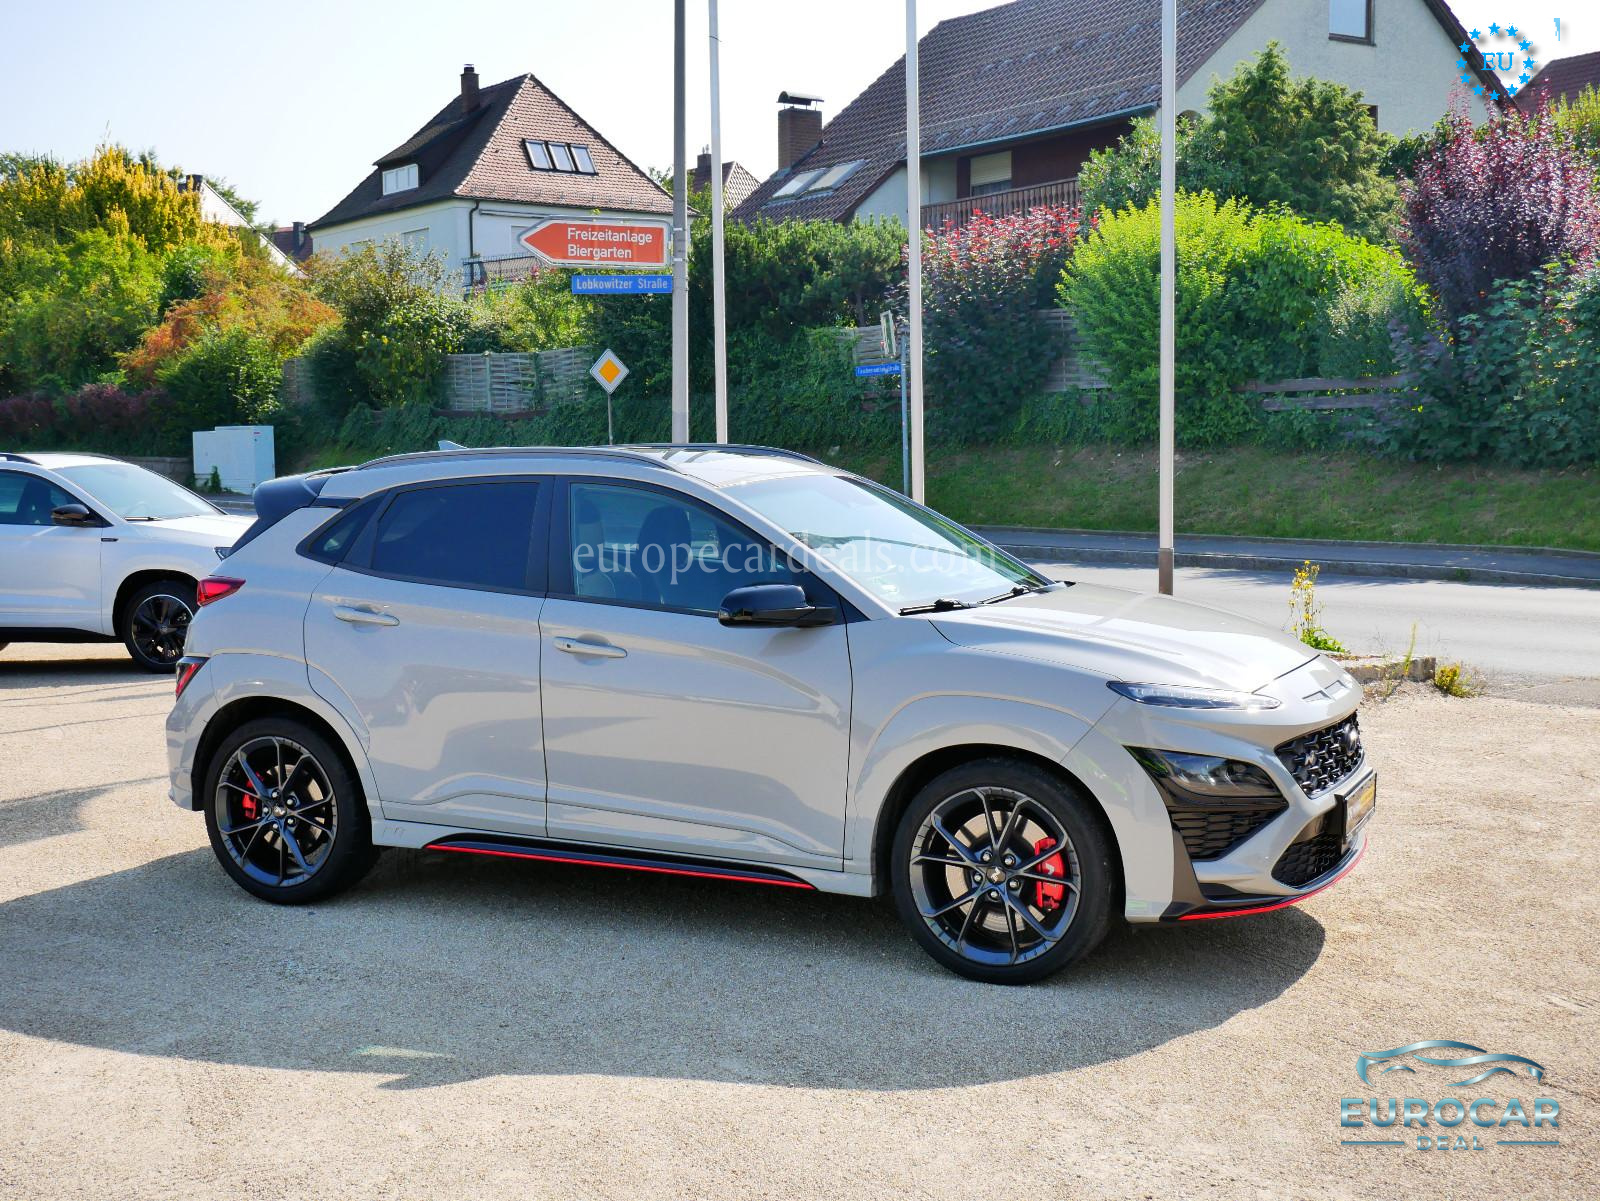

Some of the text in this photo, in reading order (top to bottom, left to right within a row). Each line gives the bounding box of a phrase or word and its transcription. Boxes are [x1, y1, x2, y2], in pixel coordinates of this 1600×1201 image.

[567, 227, 653, 245] Freizeitanlage
[567, 244, 632, 260] Biergarten
[576, 278, 668, 289] Lobkowitzer Straße
